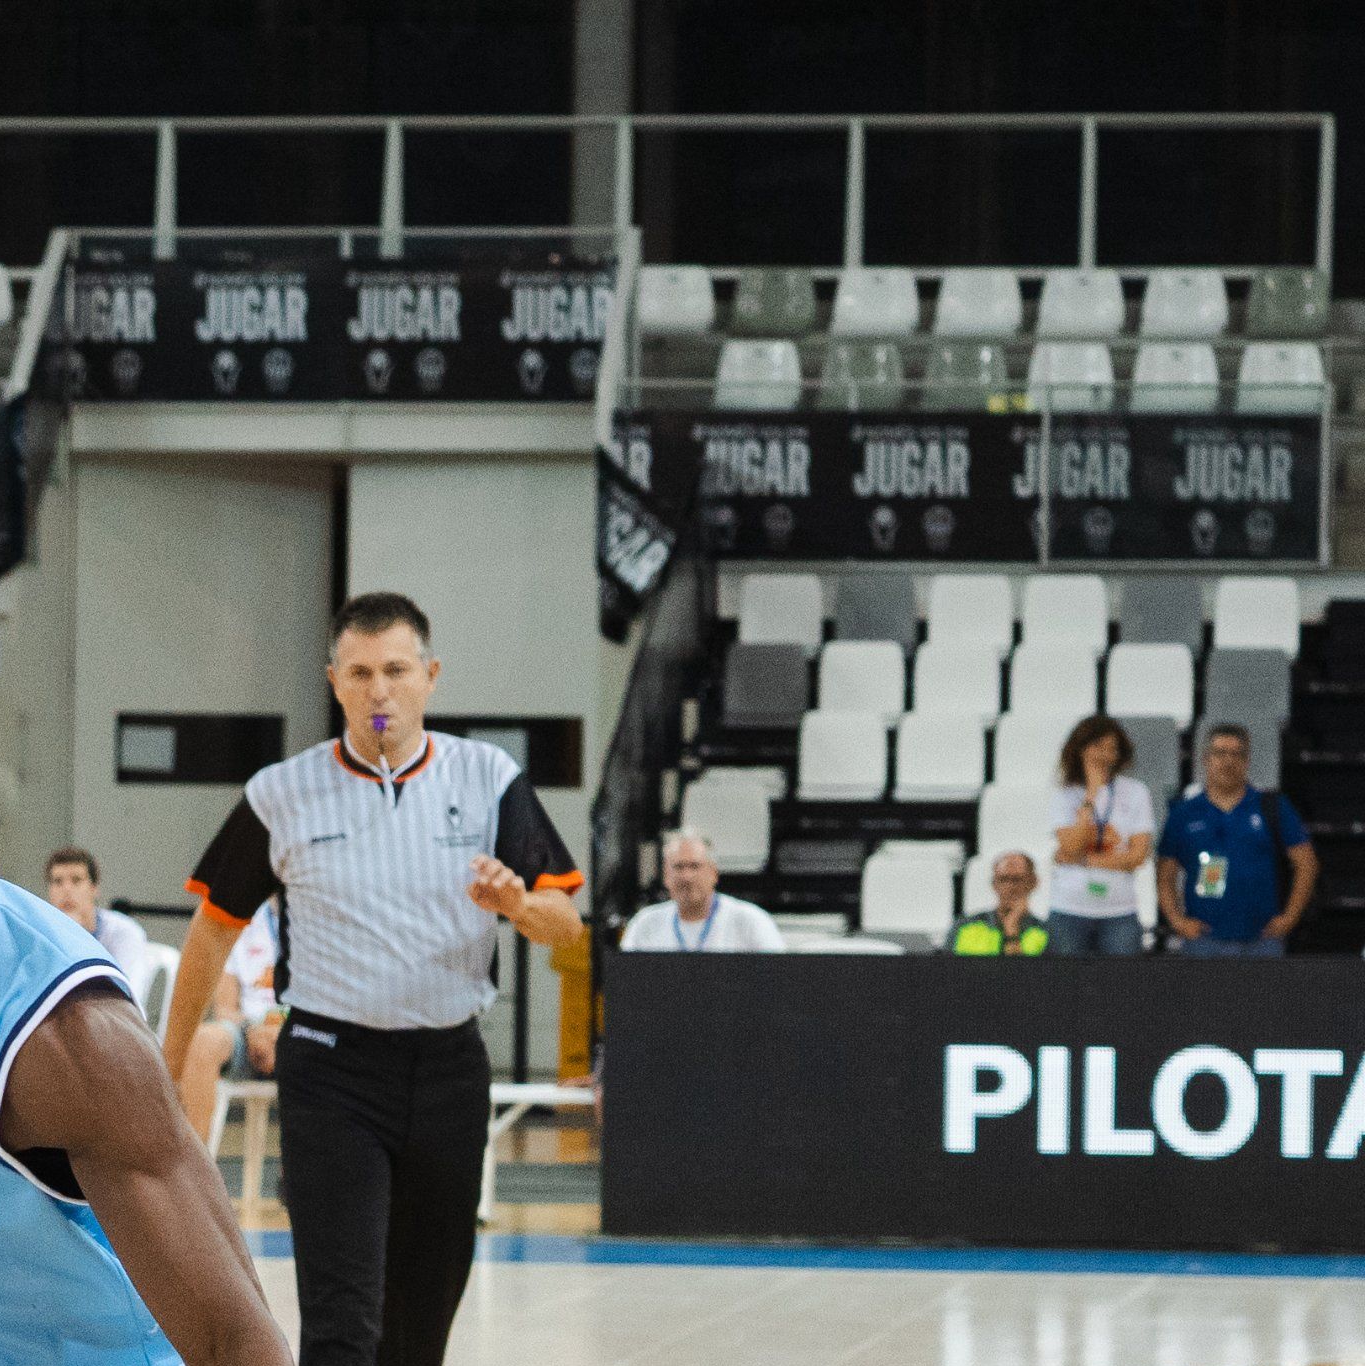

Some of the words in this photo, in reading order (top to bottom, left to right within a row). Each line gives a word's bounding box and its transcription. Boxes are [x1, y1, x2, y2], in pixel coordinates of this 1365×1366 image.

[195, 286, 308, 342] JUGAR
[348, 286, 461, 342] JUGAR
[853, 441, 968, 497] JUGAR
[1175, 443, 1292, 500] JUGAR
